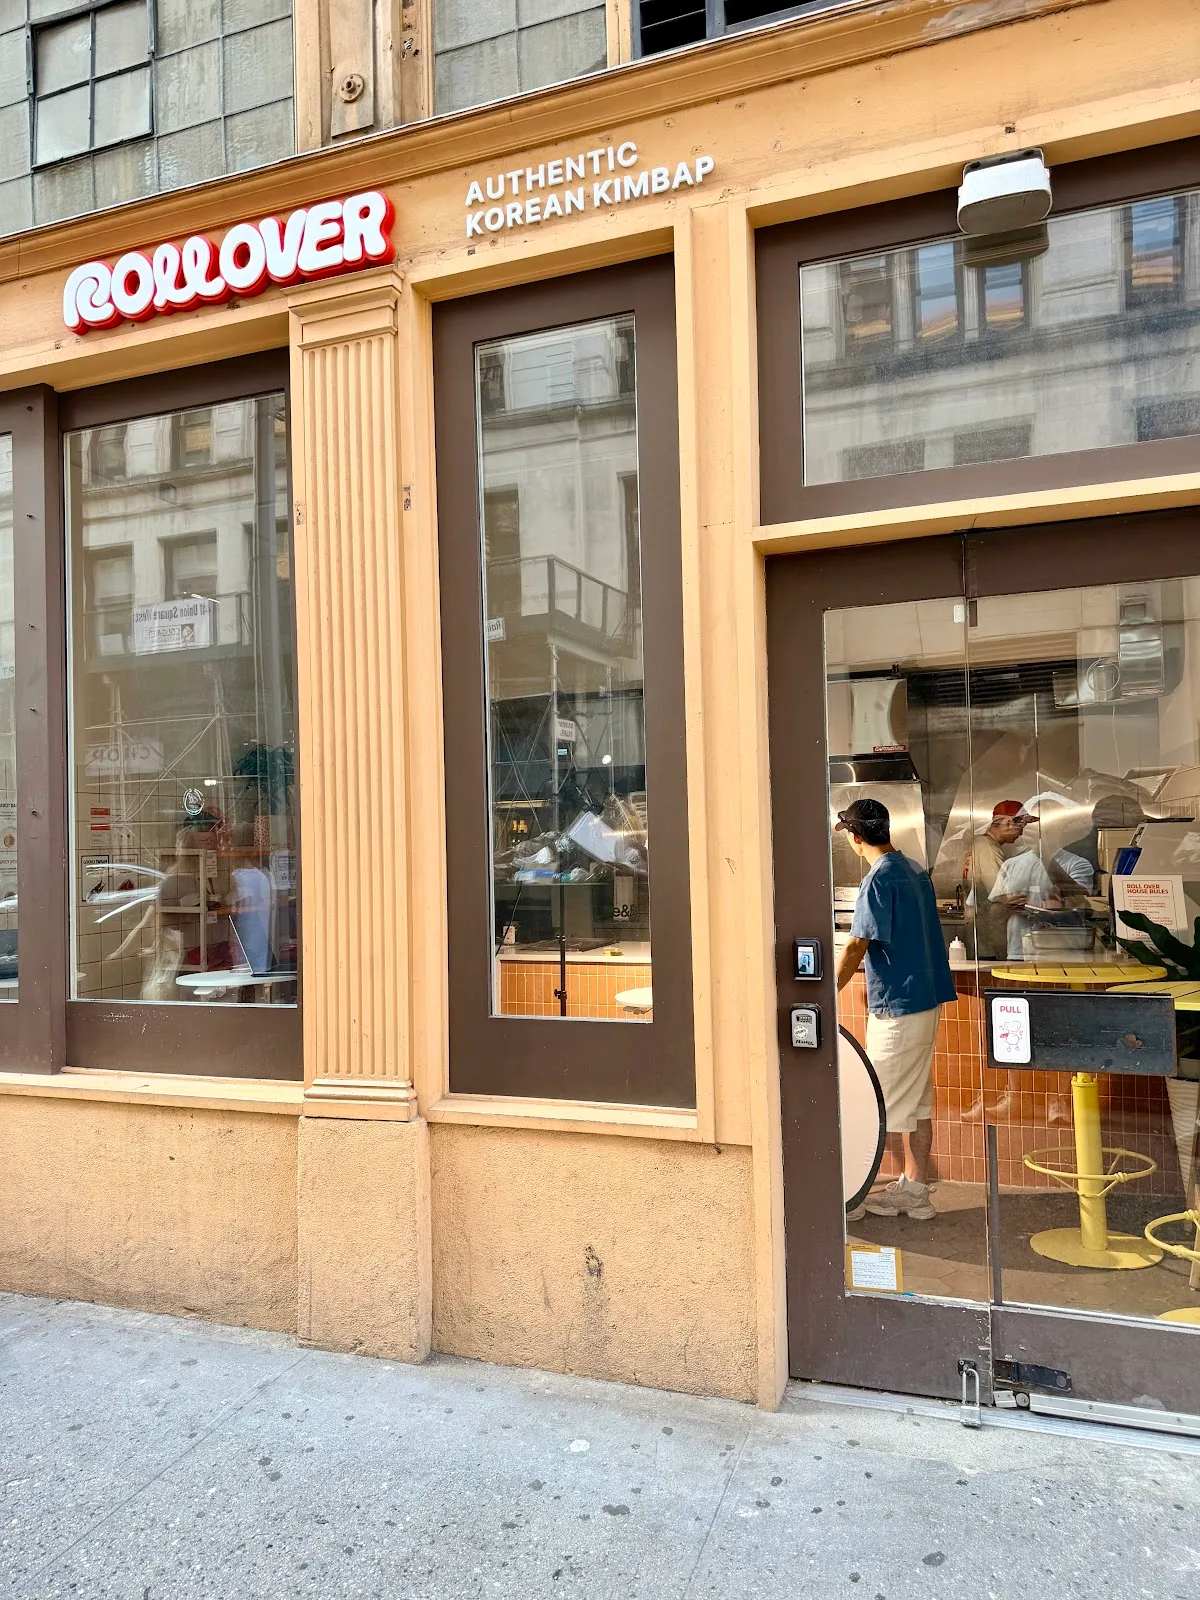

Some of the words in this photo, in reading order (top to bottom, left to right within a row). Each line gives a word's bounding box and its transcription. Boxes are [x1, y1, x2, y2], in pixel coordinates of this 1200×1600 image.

[465, 141, 638, 207] AUTHENTIC
[465, 186, 585, 239] KOREAN
[593, 155, 716, 209] KIMBAP
[999, 1005, 1022, 1014] PULL
